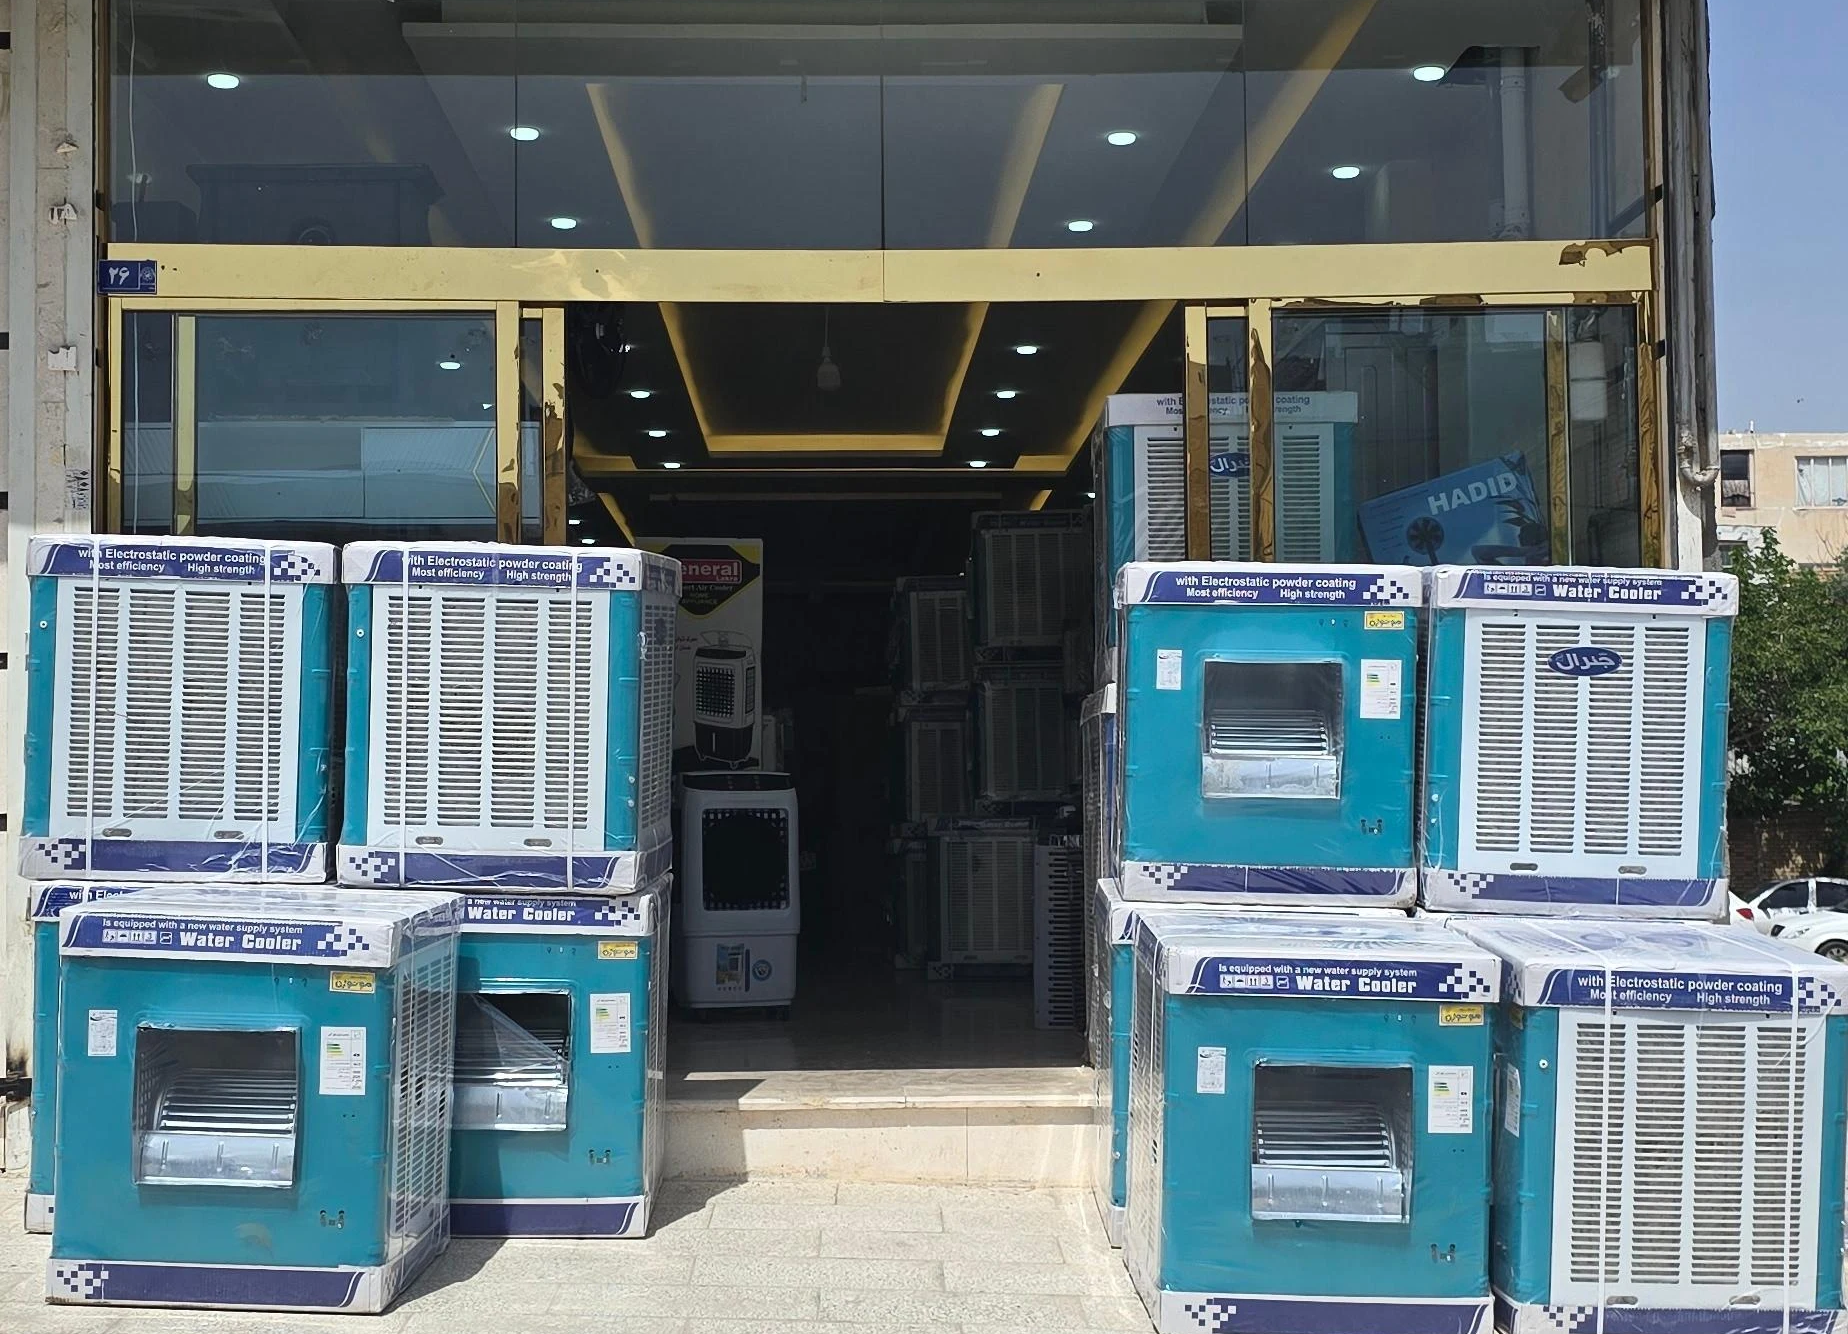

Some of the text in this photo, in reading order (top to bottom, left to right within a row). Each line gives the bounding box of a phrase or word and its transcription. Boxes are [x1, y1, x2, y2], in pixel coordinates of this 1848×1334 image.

[109, 267, 130, 285] ۲۶
[1179, 395, 1236, 405] Estatic
[1166, 406, 1184, 415] Mos
[1426, 472, 1518, 515] HADID
[105, 548, 177, 562] Electrostatic
[179, 552, 222, 564] powder
[225, 553, 266, 566] coating
[427, 555, 496, 568] Electrostatic
[499, 558, 540, 570] powder
[117, 560, 166, 573] efficiency
[187, 563, 211, 574] High
[412, 567, 571, 583] Most efficiency High strength
[681, 561, 738, 576] eneral
[1175, 576, 1356, 590] with Electrostatic powder coating
[1186, 587, 1345, 601] Most efficiency High strength
[1553, 584, 1662, 600] Water Cooler
[467, 906, 576, 921] Water Cooler
[114, 919, 156, 930] equipped
[158, 921, 177, 929] with
[208, 923, 234, 931] water
[236, 925, 267, 935] supply
[269, 925, 303, 935] system
[180, 931, 301, 950] Water Cooler
[1229, 964, 1271, 974] equipped
[1273, 965, 1293, 974] with
[1303, 966, 1322, 975] new
[1323, 967, 1349, 975] water
[1351, 967, 1382, 978] supply
[1384, 968, 1417, 978] system
[1296, 975, 1416, 993] Water Cooler
[1578, 975, 1782, 995] with Electrostatic powder coating
[1590, 988, 1770, 1006] Mot efficiency High strength
